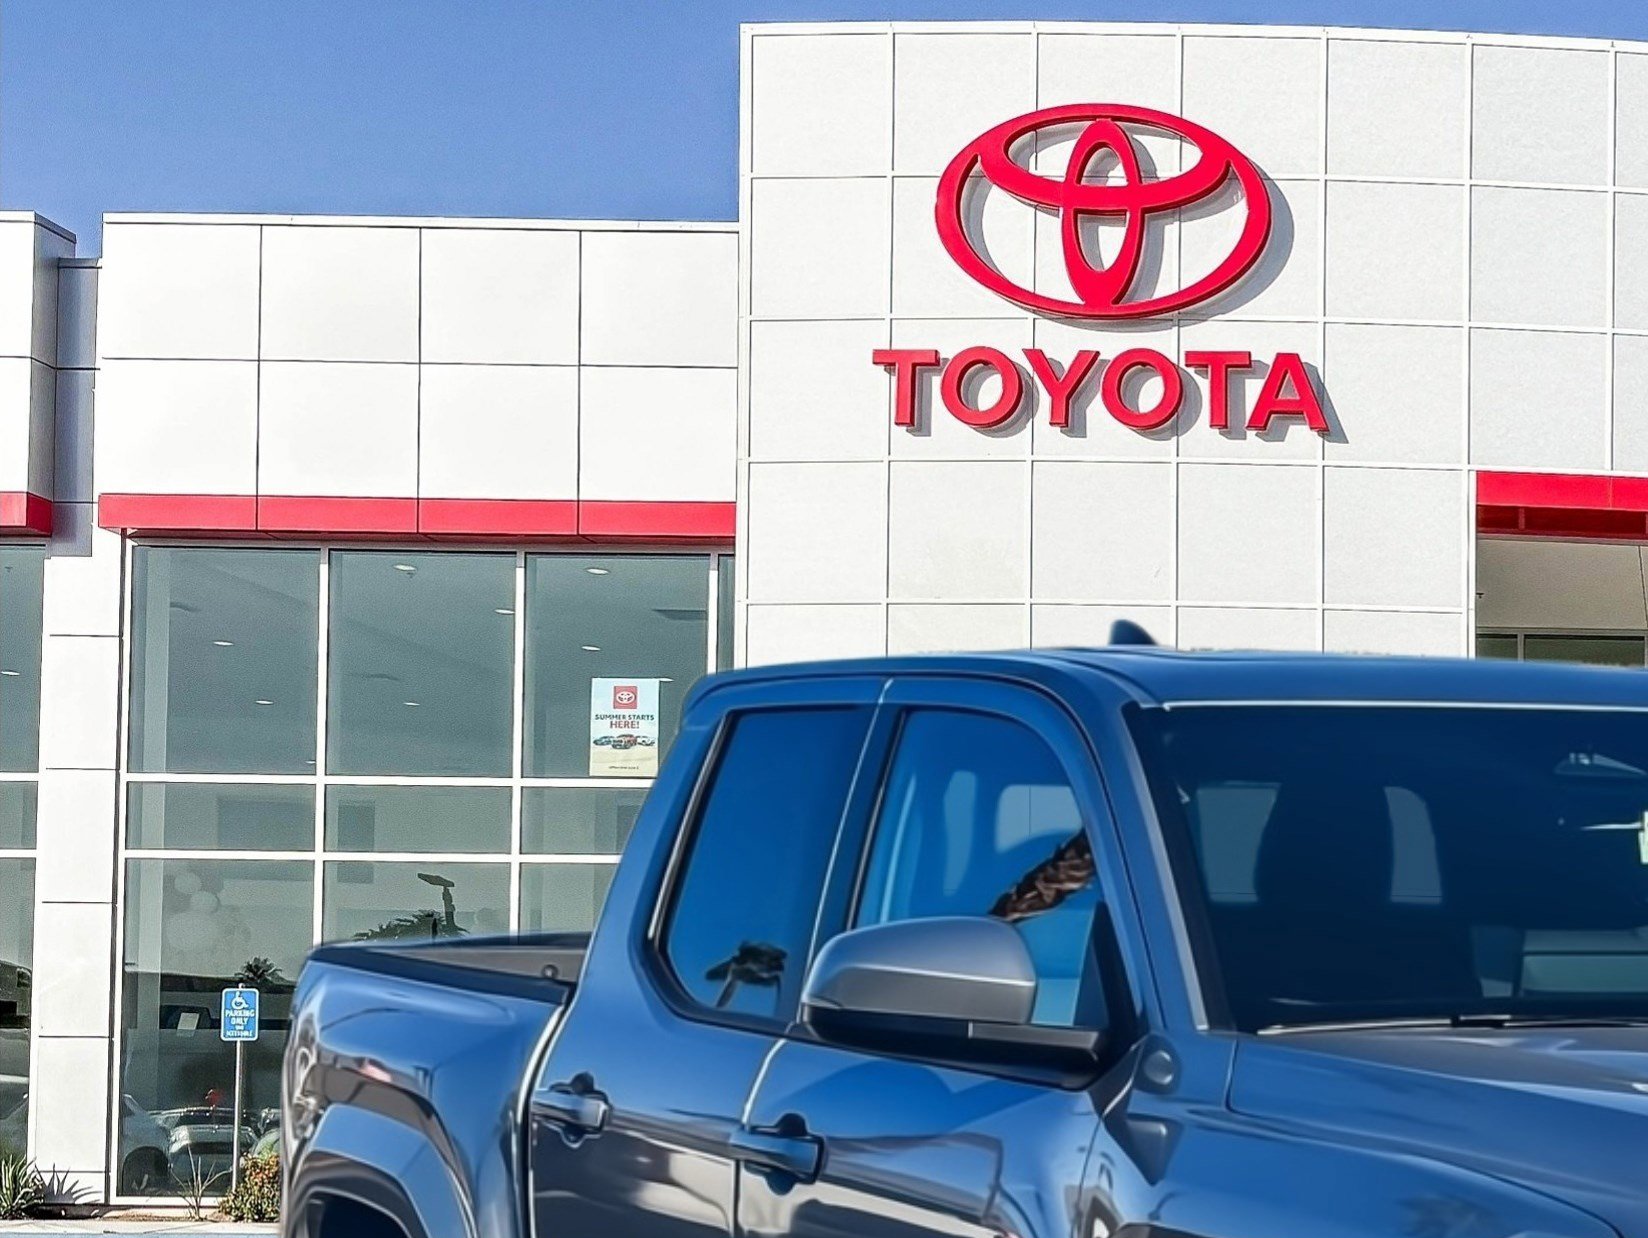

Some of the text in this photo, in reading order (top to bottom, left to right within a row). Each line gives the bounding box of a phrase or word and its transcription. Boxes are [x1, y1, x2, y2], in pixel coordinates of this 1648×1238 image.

[871, 345, 1329, 432] TOYOTA
[609, 720, 640, 729] HERE!
[225, 1009, 255, 1017] PARKING
[230, 1017, 249, 1025] ONLY
